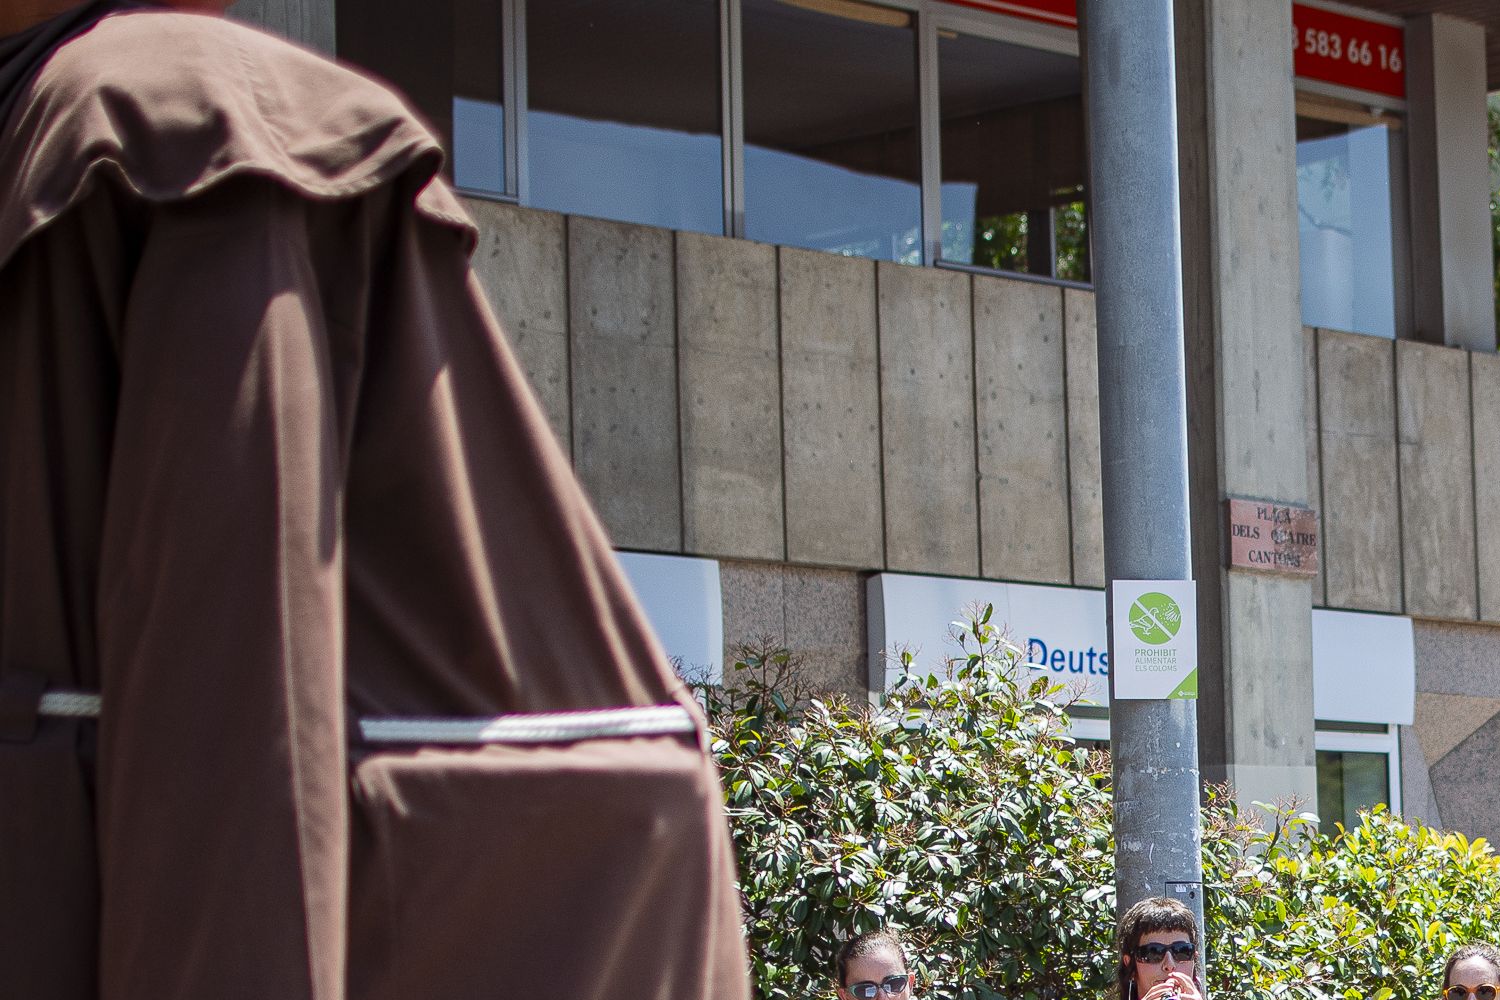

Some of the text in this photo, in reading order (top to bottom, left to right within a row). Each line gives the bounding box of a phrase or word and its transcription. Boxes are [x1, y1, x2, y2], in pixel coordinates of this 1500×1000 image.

[1305, 27, 1342, 59] 583
[1347, 37, 1373, 66] 66
[1378, 44, 1402, 73] 16
[1232, 523, 1260, 540] DELS
[1134, 648, 1177, 657] PROHIBIT
[1134, 657, 1178, 665] ALIMENTAR
